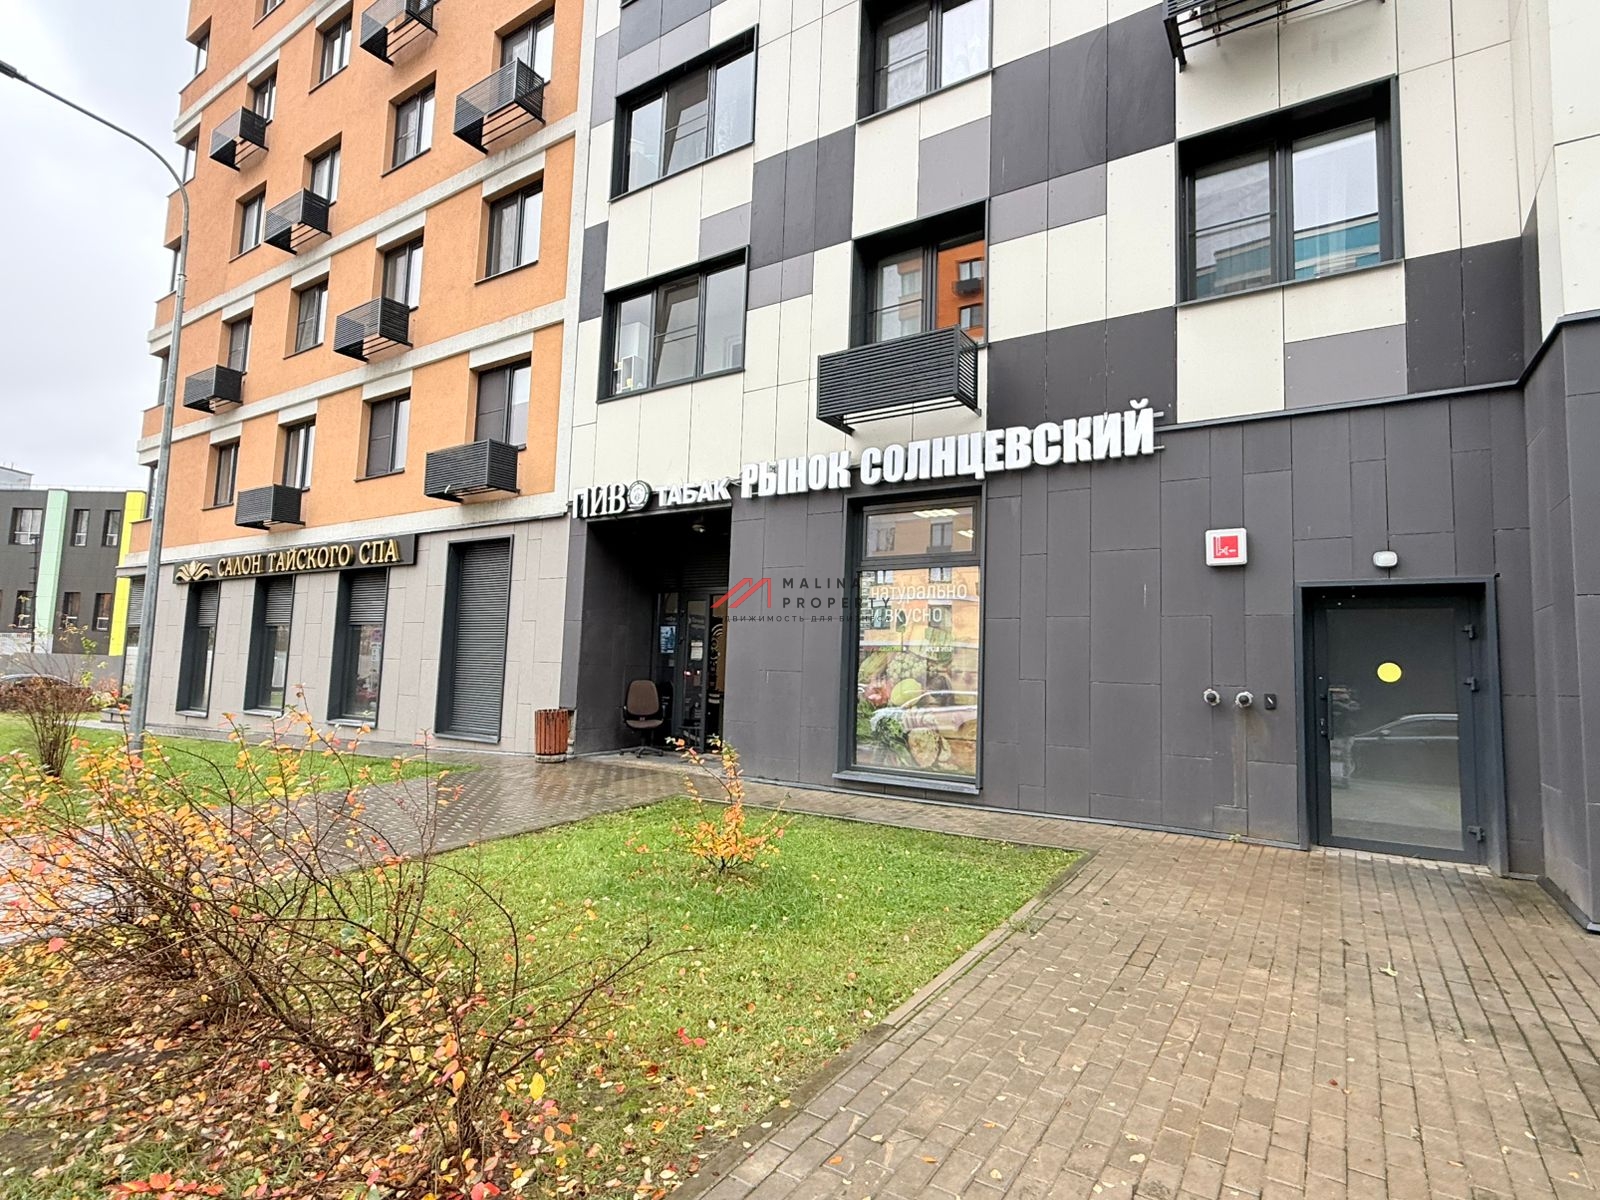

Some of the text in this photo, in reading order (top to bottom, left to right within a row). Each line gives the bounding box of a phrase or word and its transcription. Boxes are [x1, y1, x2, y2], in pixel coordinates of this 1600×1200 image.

[740, 398, 1155, 498] РЫНОК СОЛНЦЕВСКИЙ
[657, 478, 733, 507] ТАБАК
[217, 539, 400, 577] САЛОН ТАЙСКОГО СПА
[870, 583, 968, 604] натурально
[885, 607, 942, 625] вкусно
